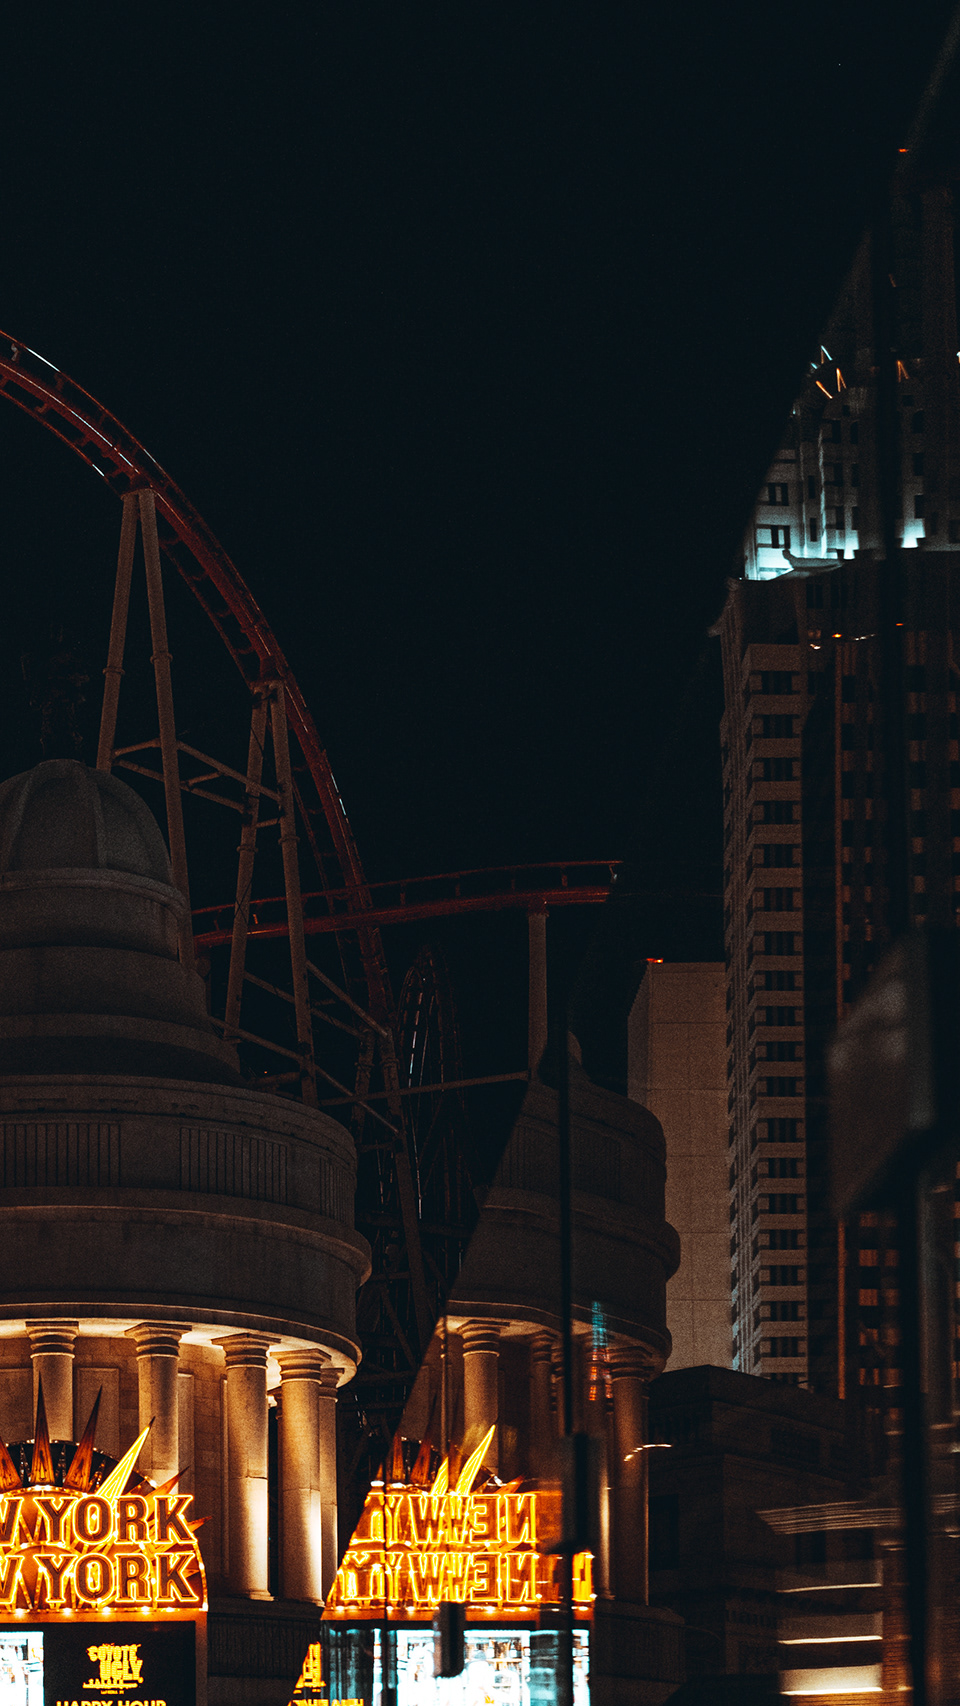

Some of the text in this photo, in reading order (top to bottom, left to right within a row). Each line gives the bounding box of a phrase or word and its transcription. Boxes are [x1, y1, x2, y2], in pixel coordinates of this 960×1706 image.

[33, 1494, 199, 1546] YORK
[33, 1552, 200, 1605] YORK
[86, 1644, 142, 1662] COYOTE
[99, 1659, 144, 1681] UGLY
